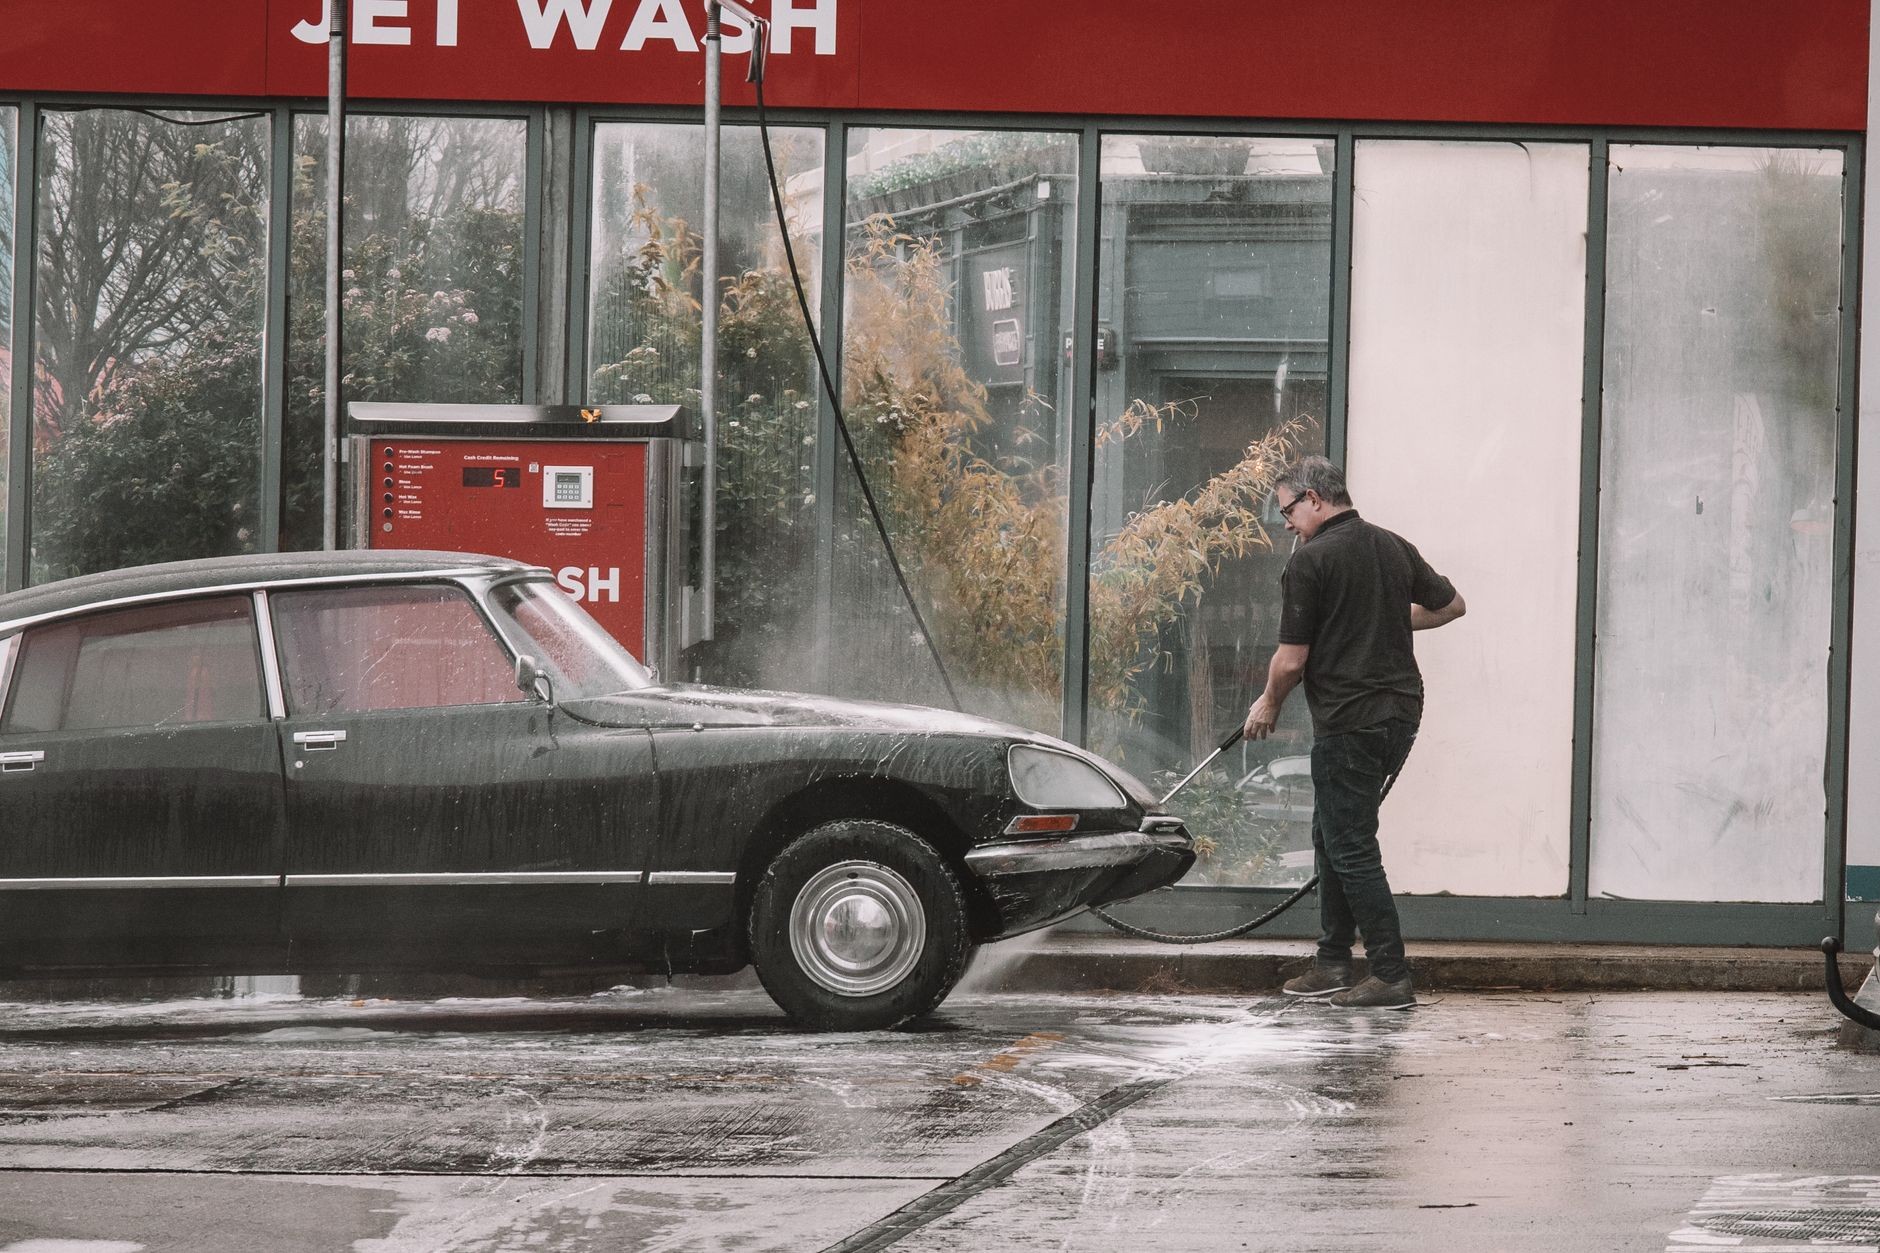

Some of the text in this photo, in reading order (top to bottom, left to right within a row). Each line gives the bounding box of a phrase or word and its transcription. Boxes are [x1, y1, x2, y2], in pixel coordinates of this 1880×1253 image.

[290, 0, 836, 55] JET WASH
[493, 469, 505, 488] 5
